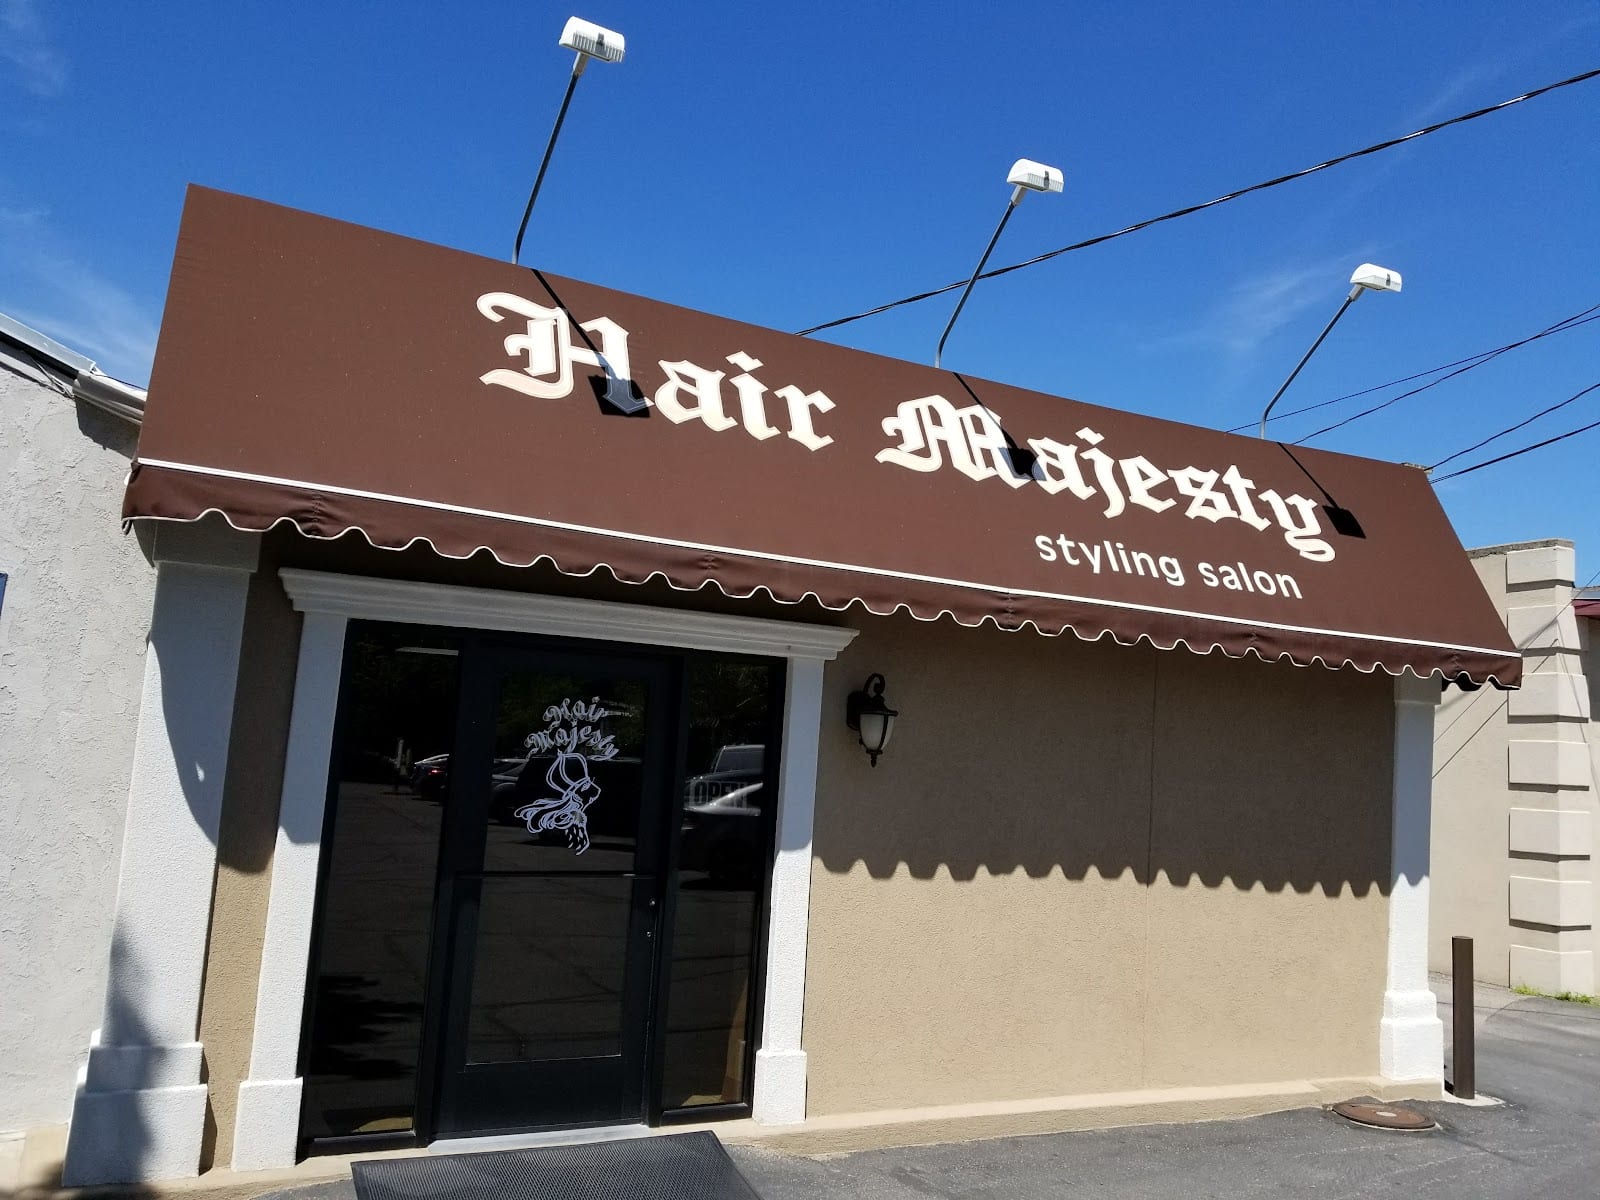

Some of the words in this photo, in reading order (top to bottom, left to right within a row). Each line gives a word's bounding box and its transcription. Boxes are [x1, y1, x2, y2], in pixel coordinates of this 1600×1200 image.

[476, 291, 837, 452] Hair
[874, 394, 1336, 563] Majesty
[1034, 532, 1186, 587] styling
[1197, 561, 1303, 600] salon
[523, 719, 620, 761] Majesty
[542, 695, 609, 730] Hair
